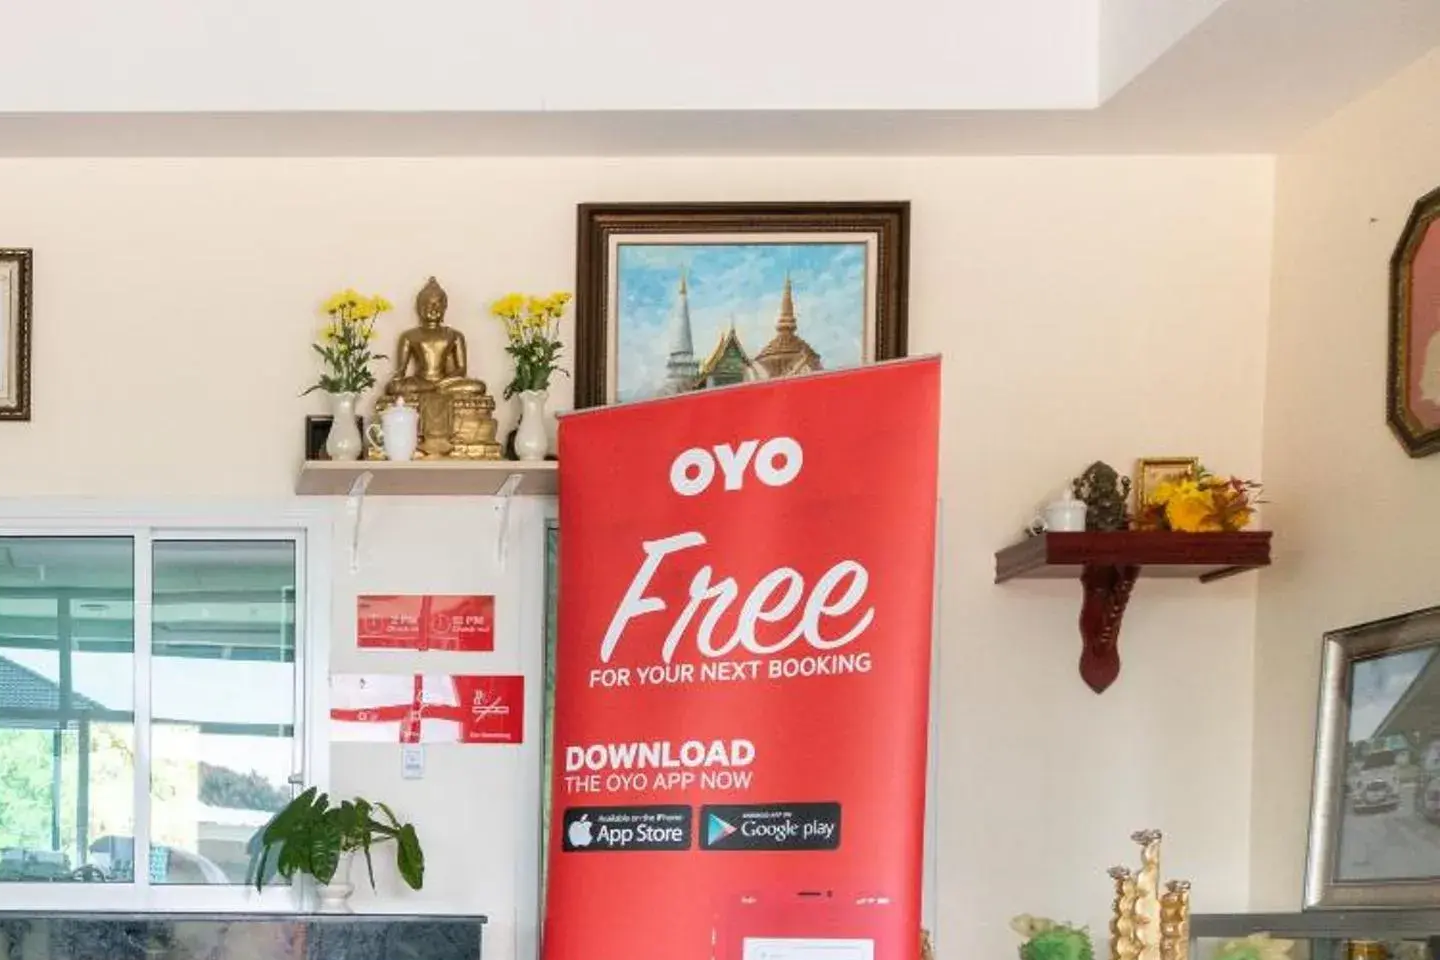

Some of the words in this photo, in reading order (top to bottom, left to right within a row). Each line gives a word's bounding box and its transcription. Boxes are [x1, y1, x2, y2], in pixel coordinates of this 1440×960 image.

[670, 436, 804, 496] OYO
[600, 531, 876, 664] Free
[589, 667, 630, 688] FOR
[636, 662, 694, 685] YOUR
[700, 660, 761, 683] NEXT
[768, 652, 873, 679] BOOKING
[565, 738, 756, 772] DOWNLOAD
[565, 774, 601, 794] THE
[605, 773, 647, 792] OYO
[652, 773, 695, 791] APP
[700, 771, 753, 790] NOW
[597, 825, 634, 846] App
[637, 824, 683, 842] Store
[741, 819, 800, 841] Google
[803, 819, 835, 840] play
